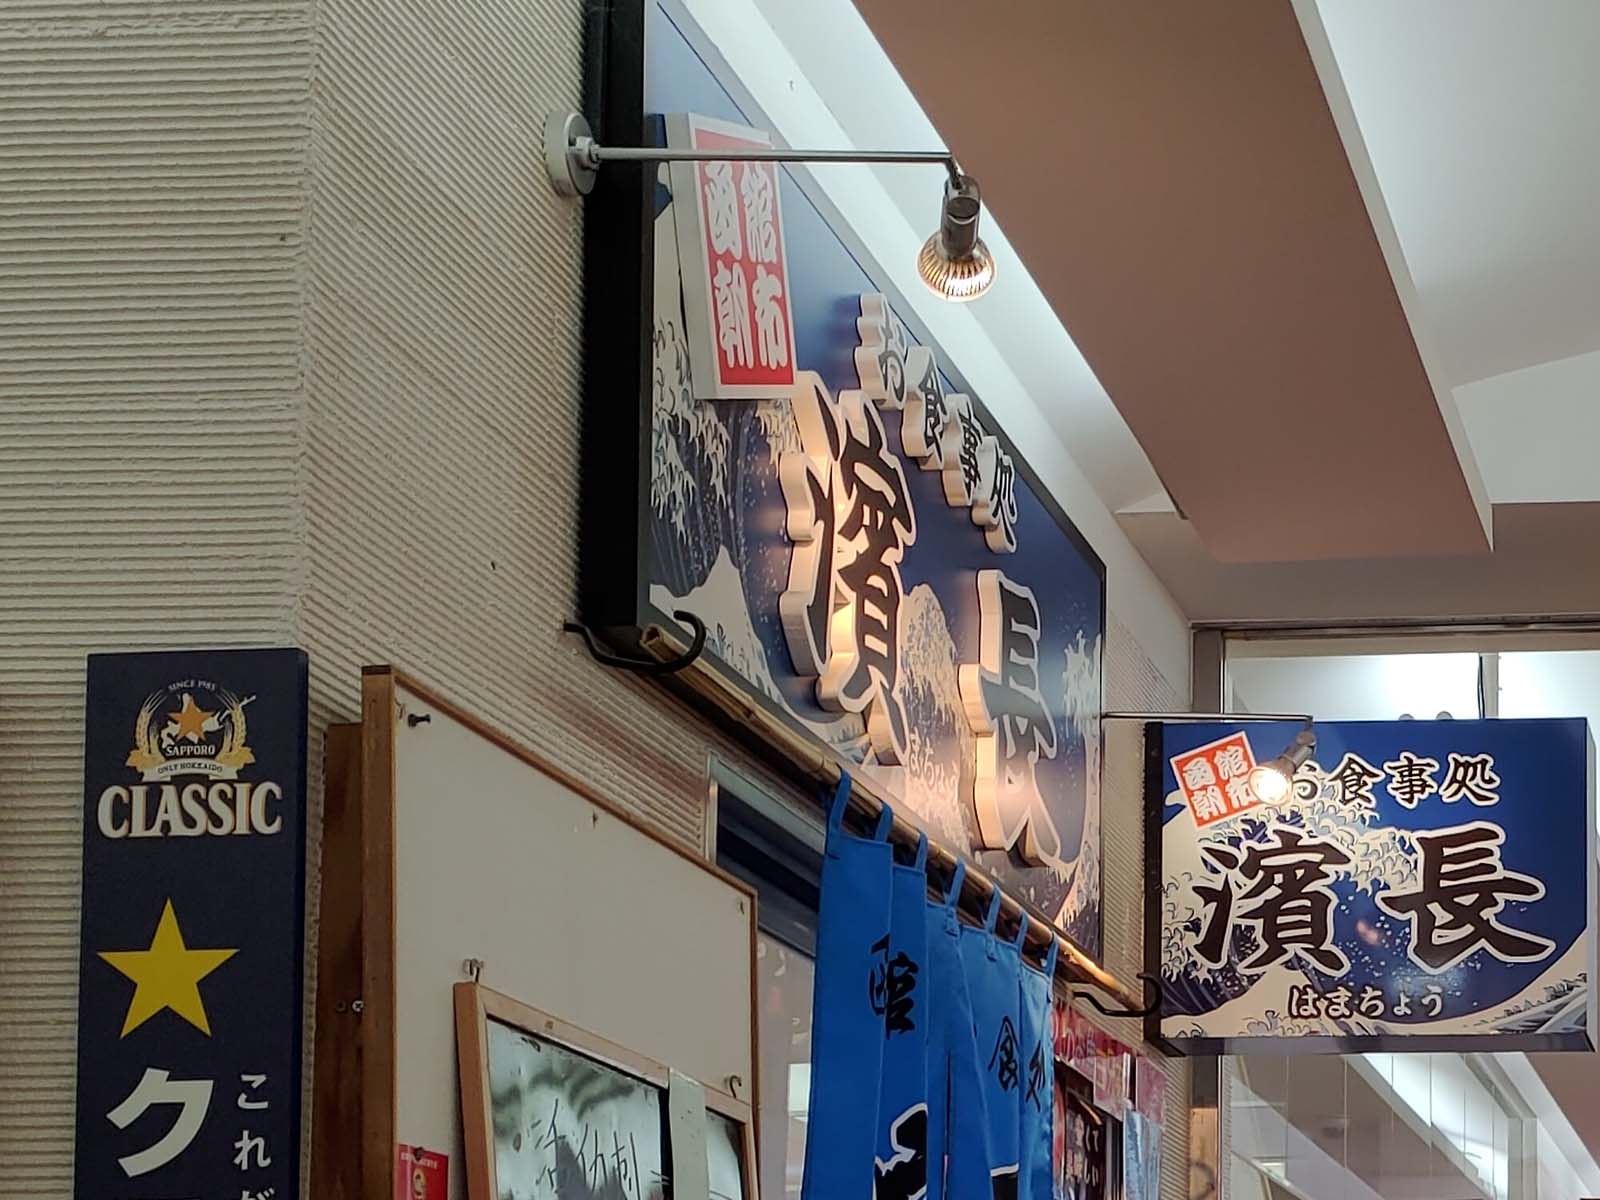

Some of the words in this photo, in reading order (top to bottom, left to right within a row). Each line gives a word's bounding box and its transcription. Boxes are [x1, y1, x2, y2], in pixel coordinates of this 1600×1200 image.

[158, 762, 179, 774] ONLY
[180, 761, 224, 773] HOKKAIDO
[166, 745, 216, 756] SAPPORO
[98, 781, 283, 839] CLASSIC
[1194, 825, 1556, 970] 濱長
[1288, 985, 1446, 1019] はまちょう
